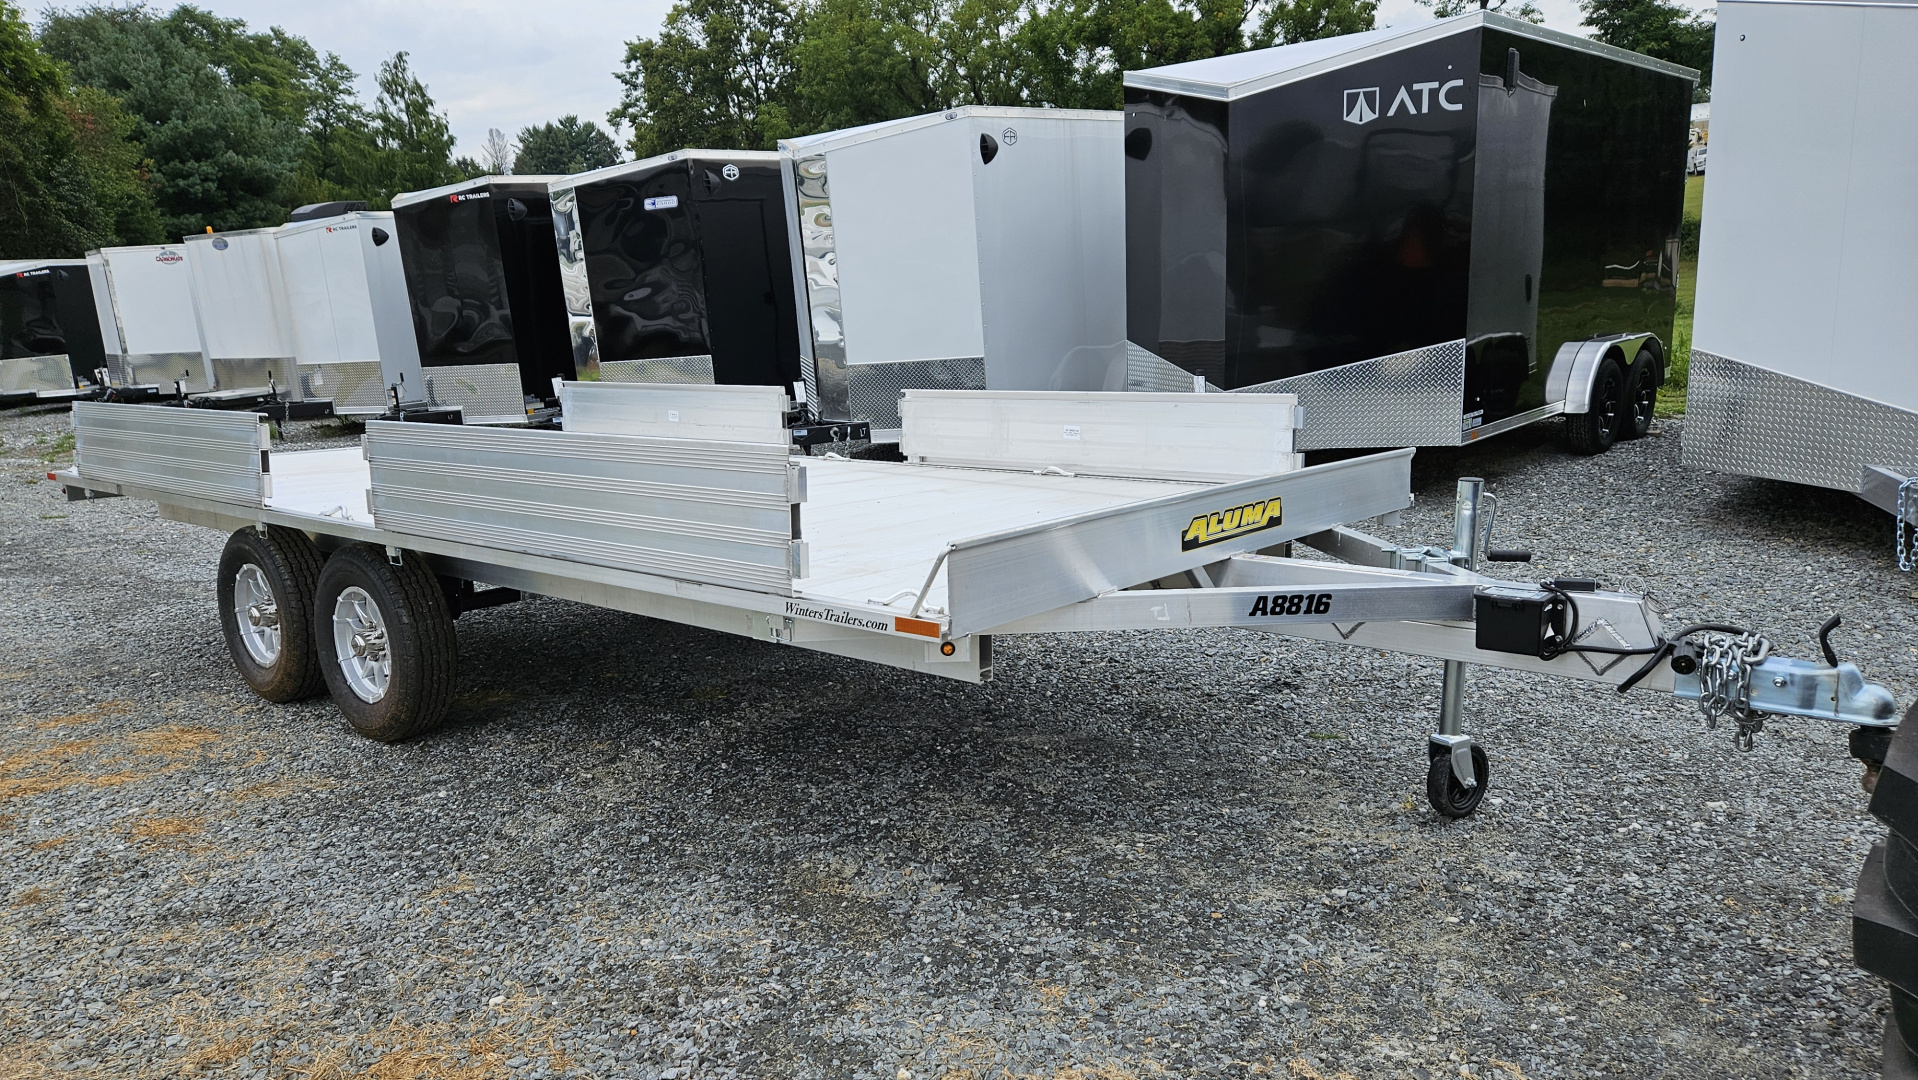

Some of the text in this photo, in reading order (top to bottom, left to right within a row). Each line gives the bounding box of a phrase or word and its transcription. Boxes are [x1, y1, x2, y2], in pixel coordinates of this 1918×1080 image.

[1386, 79, 1464, 117] ATC
[466, 192, 490, 200] TRAILERS
[860, 427, 867, 437] LT
[1184, 499, 1281, 544] ALUMA
[785, 601, 889, 632] WintersTrailers.com
[1248, 593, 1333, 617] A8816
